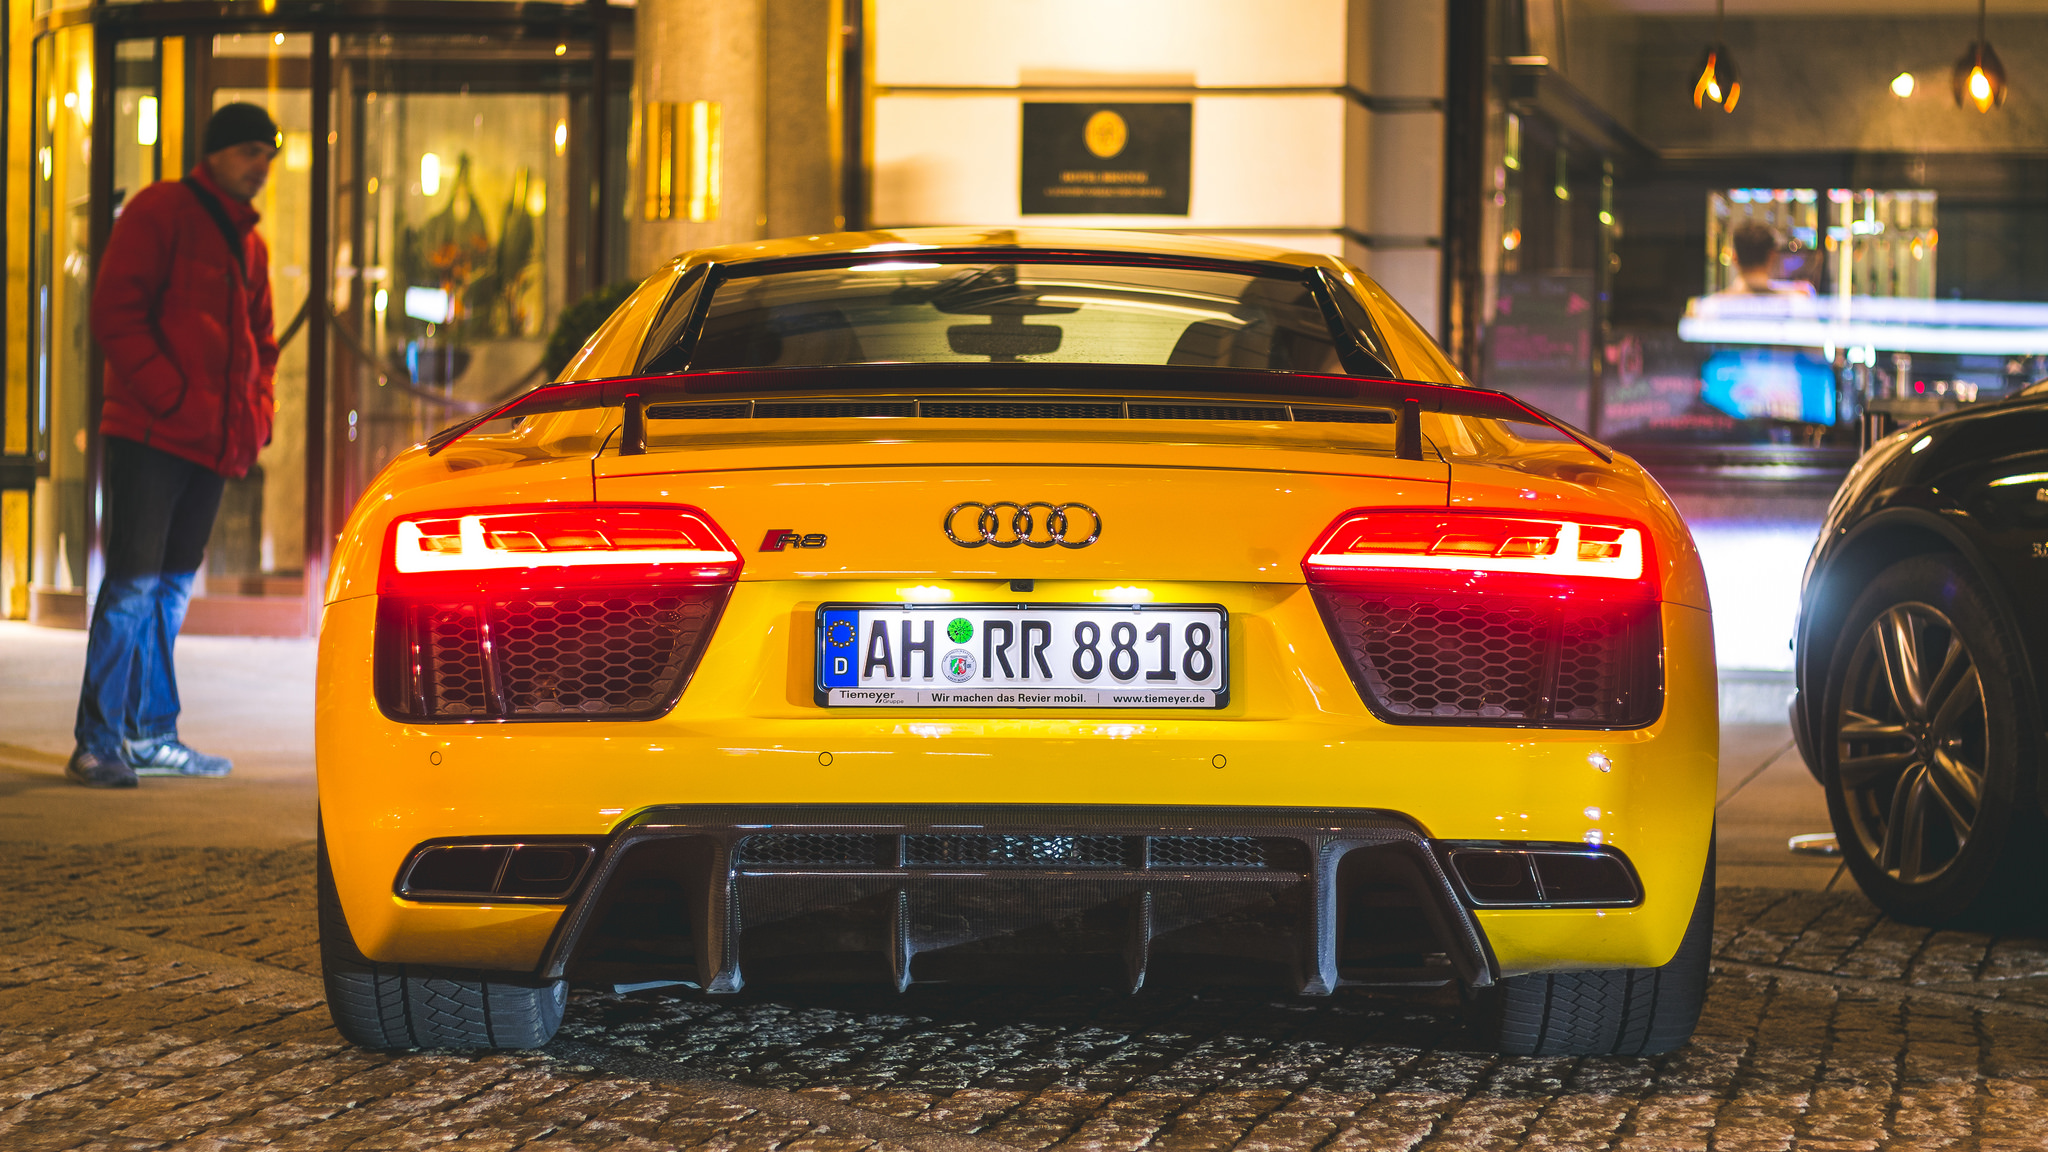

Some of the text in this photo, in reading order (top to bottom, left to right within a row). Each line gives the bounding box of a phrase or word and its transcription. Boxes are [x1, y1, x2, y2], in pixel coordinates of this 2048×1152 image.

[774, 534, 828, 549] R8
[863, 620, 1213, 681] AH RR 8818
[834, 657, 848, 675] D
[839, 690, 896, 703] Tiemeyer
[931, 693, 1087, 703] Wir machen das Revier mobil.
[1113, 694, 1205, 705] www.tiemeyer.de
